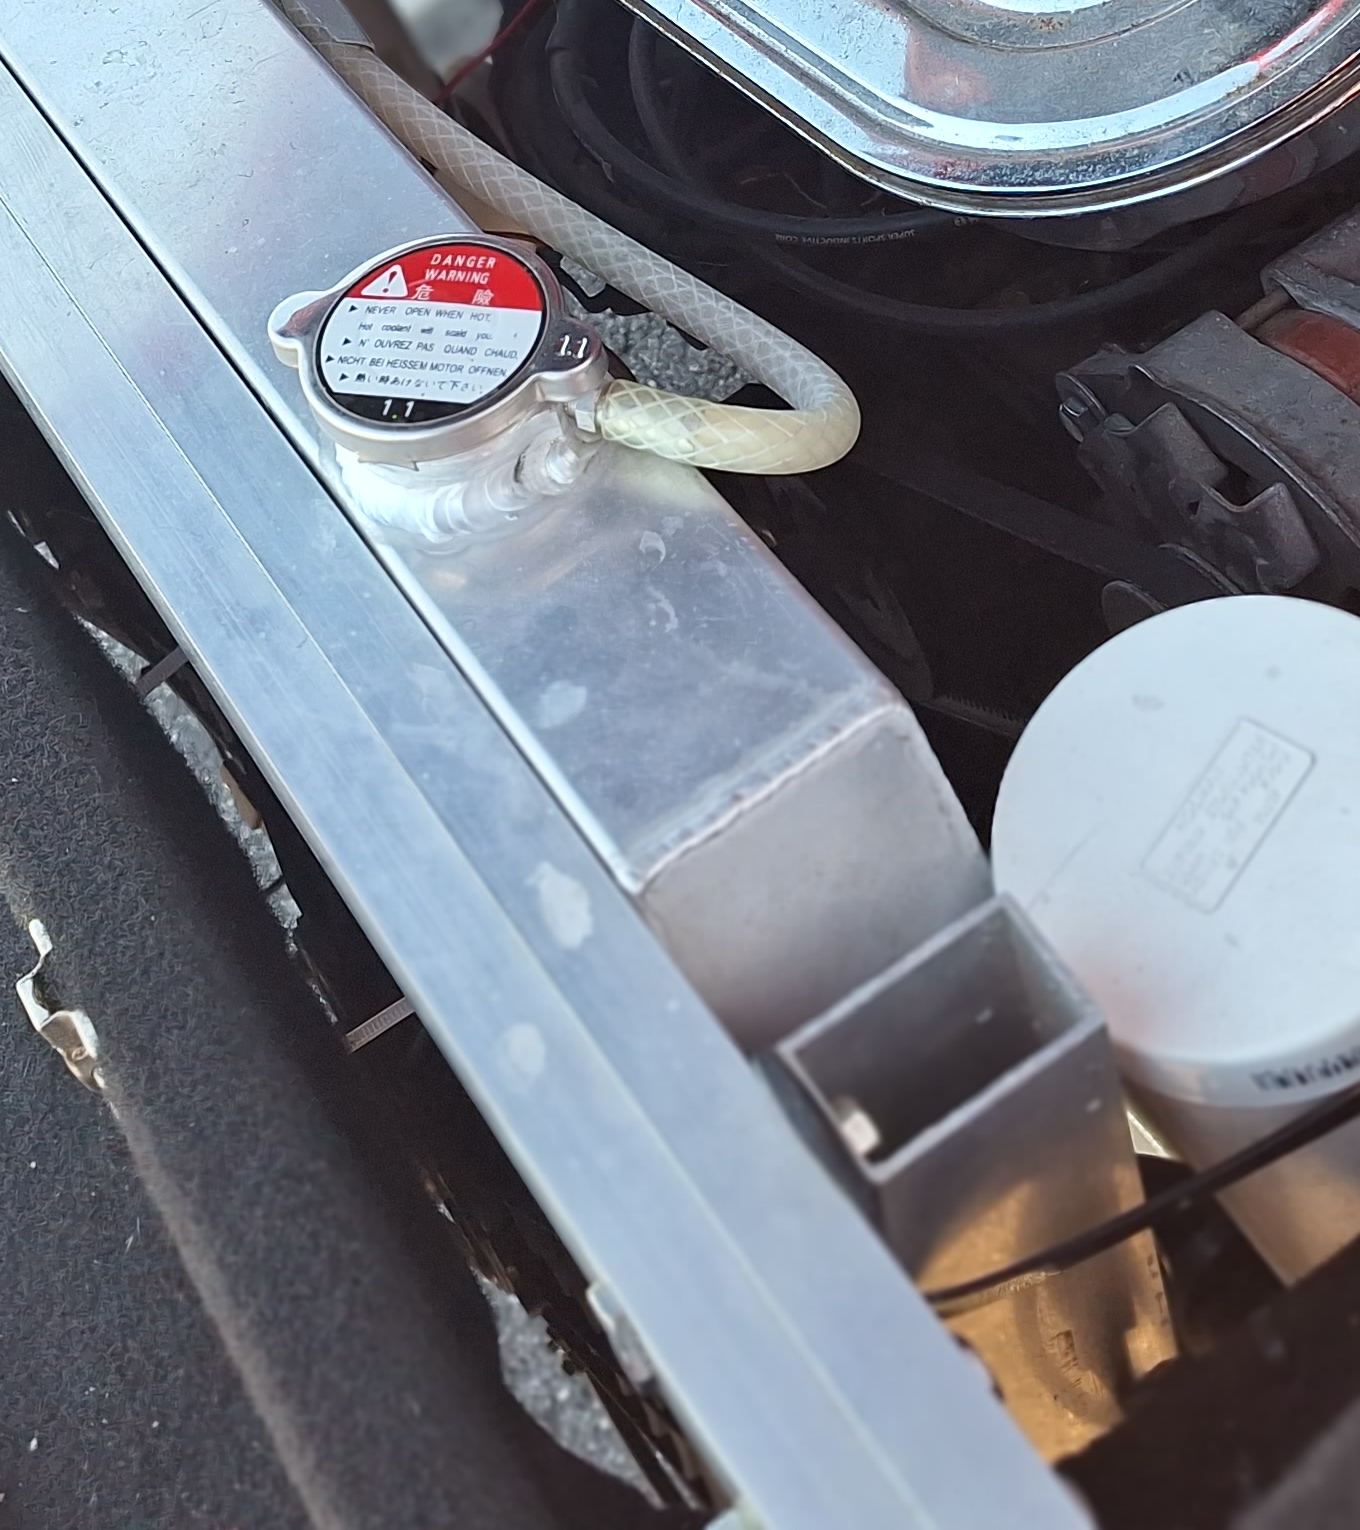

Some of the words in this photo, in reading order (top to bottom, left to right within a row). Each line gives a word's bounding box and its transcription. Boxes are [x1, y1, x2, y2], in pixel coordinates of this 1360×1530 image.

[430, 253, 497, 269] DANGER
[424, 268, 491, 285] WARNING
[365, 305, 397, 315] NEVER
[405, 306, 431, 316] OPEN
[435, 309, 464, 319] WHEN
[358, 322, 373, 331] Hot
[381, 324, 412, 333] coolant
[374, 339, 413, 351] OUVREZ
[416, 342, 435, 352] PAS
[443, 344, 478, 356] QUAND
[555, 334, 588, 360] 1.1
[337, 355, 367, 366] NICHT
[369, 357, 384, 367] BEI
[386, 359, 429, 371] HEISSEM
[429, 362, 464, 374] MOTOR
[382, 399, 415, 421] 1.1
